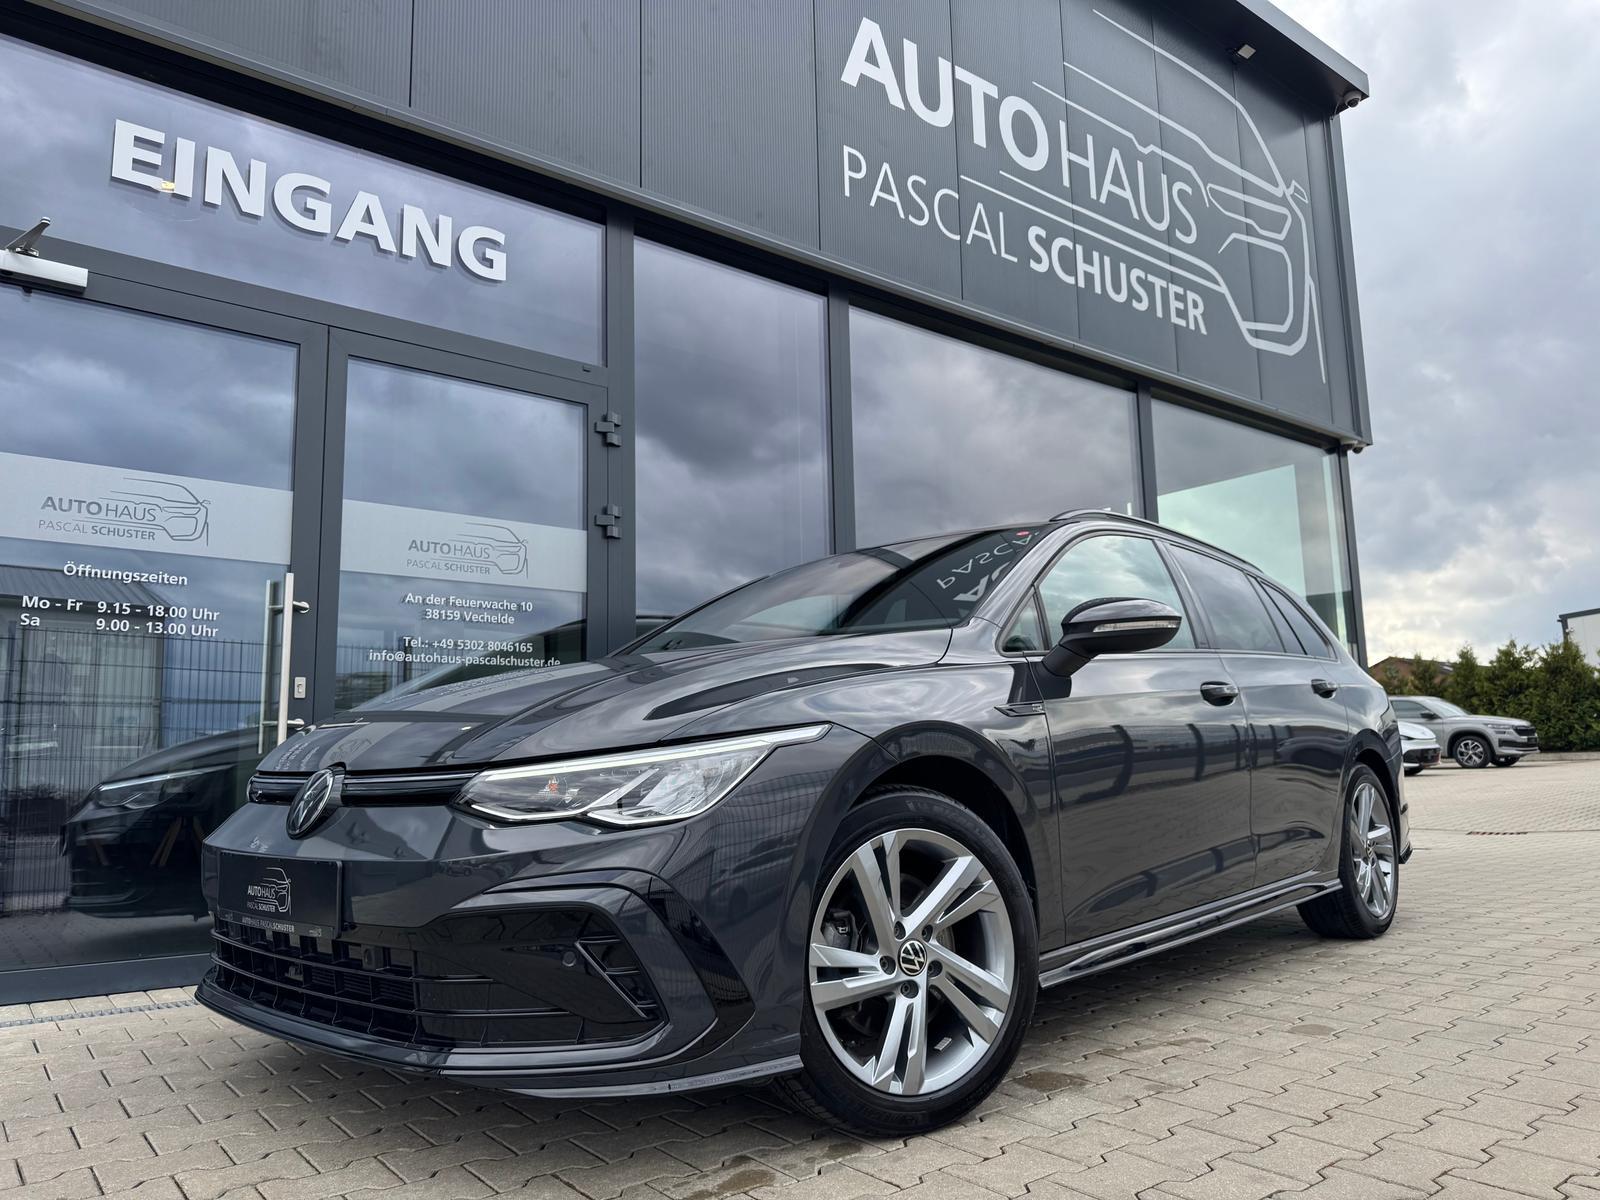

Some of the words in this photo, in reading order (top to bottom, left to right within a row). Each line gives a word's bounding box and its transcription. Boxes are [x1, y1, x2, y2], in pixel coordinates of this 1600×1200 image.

[841, 17, 1197, 244] AUTOHAUS
[111, 119, 507, 281] EINGANG
[842, 145, 1018, 263] PASCAL
[1027, 226, 1207, 335] SCHUSTER
[41, 496, 156, 522] AUTOHAUS
[38, 520, 89, 535] PASCAL
[91, 525, 156, 541] SCHUSTER
[408, 539, 491, 559] AUTOHAUS
[63, 561, 188, 586] Öffnungszeiten
[406, 559, 443, 571] PASCAL
[444, 563, 490, 575] SCHUSTER
[22, 596, 50, 609] Mo
[67, 599, 83, 612] Fr
[97, 601, 131, 615] 9.15
[147, 605, 188, 619] 18.00
[192, 608, 220, 621] Uhr
[405, 593, 422, 604] An
[426, 593, 446, 605] der
[450, 596, 517, 611] Feuerwache
[521, 602, 533, 612] 10
[20, 613, 40, 626] Sa
[96, 619, 129, 632] 9.00
[146, 622, 186, 635] 13.00
[191, 625, 219, 638] Uhr
[425, 609, 460, 621] 38159
[464, 612, 515, 625] Vechelde
[403, 637, 429, 648] Tel.:
[432, 639, 454, 649] +49
[457, 640, 484, 651] 5302
[488, 642, 533, 653] 8046165
[369, 650, 561, 668] info@autohaus-pascalschuster.de
[247, 885, 276, 899] AUTOHAUS
[259, 904, 276, 913] SCHUSTER
